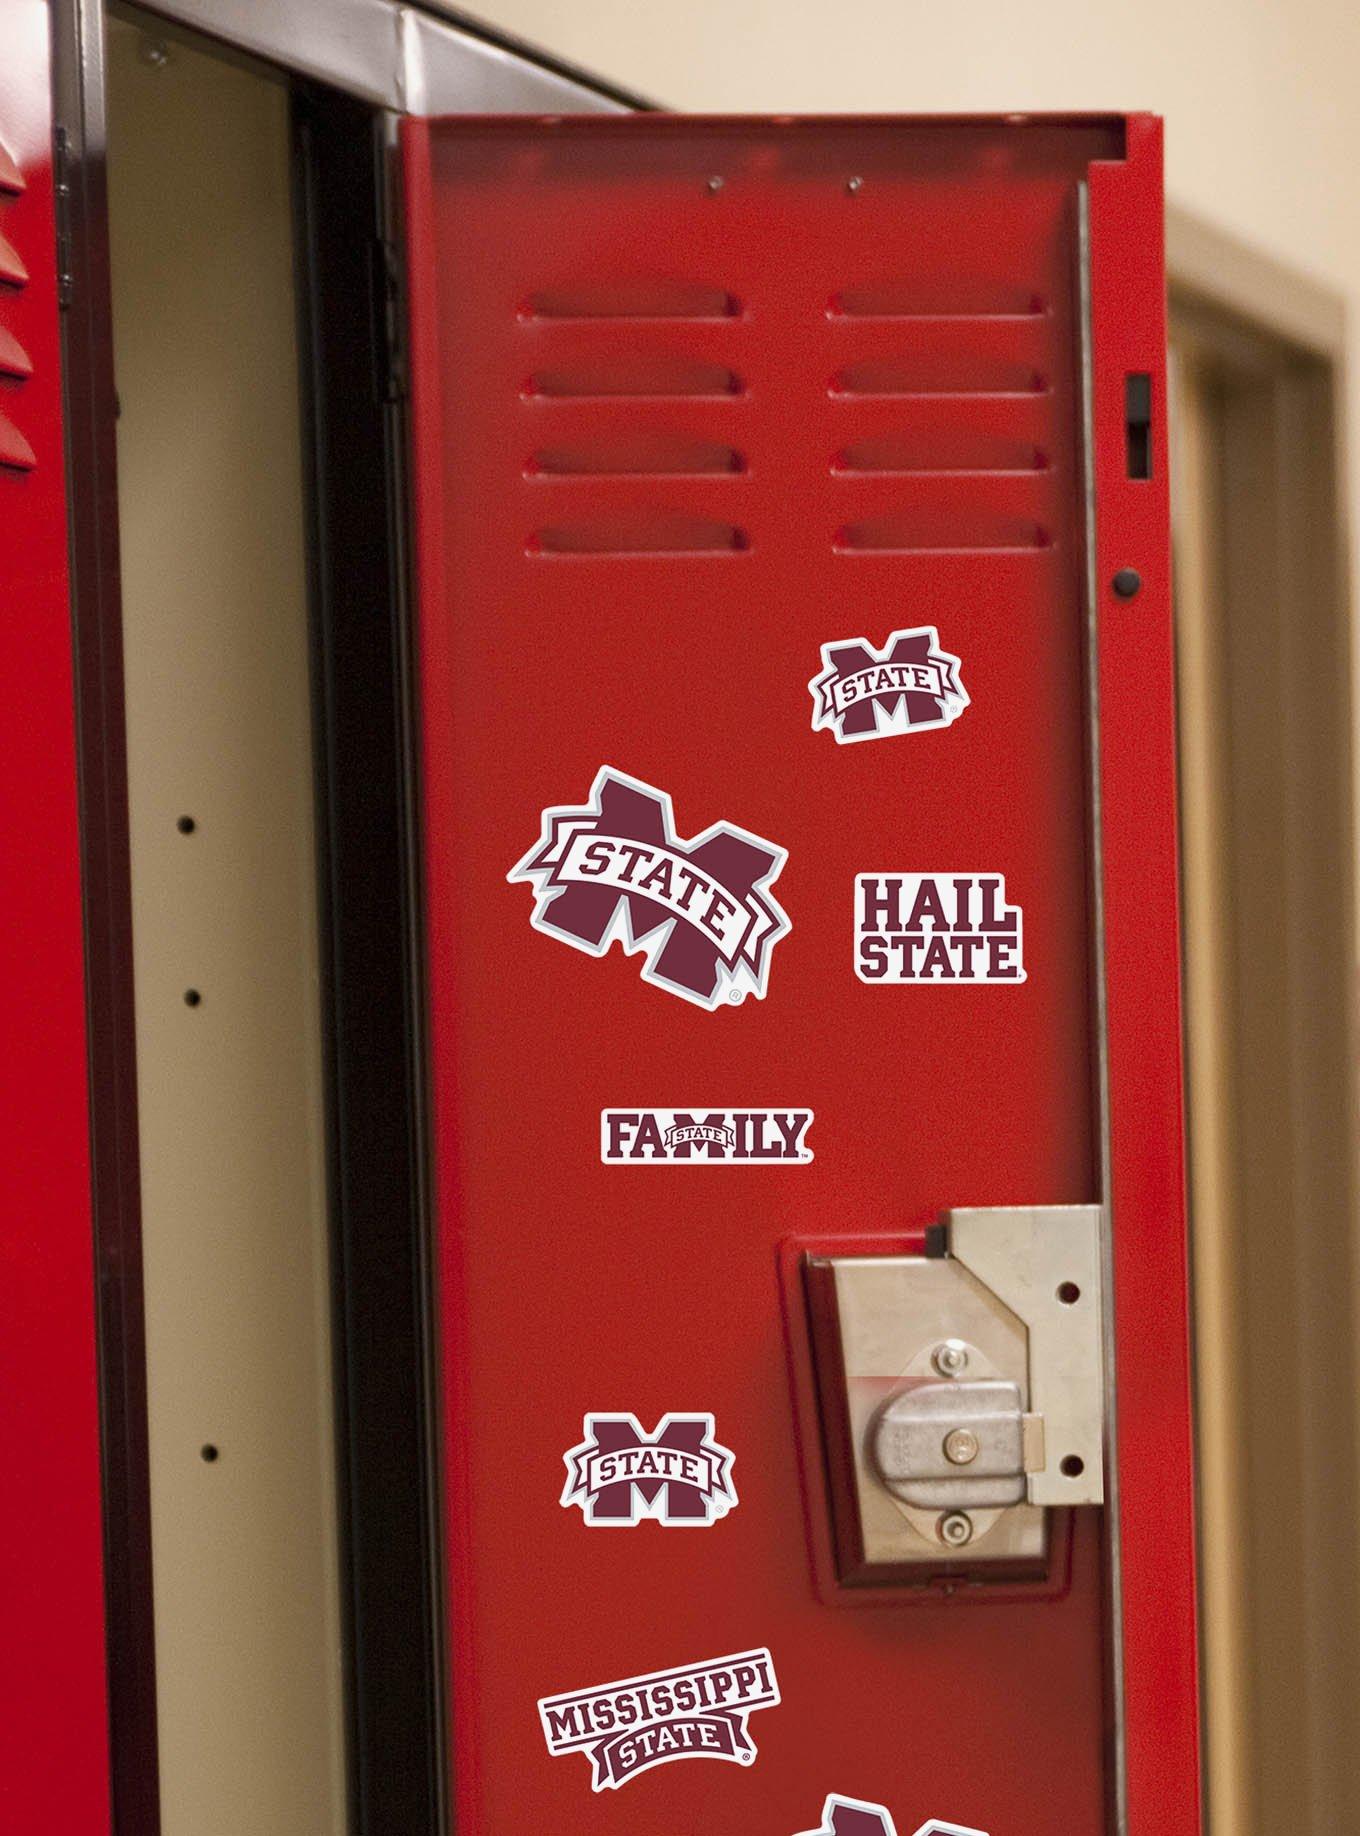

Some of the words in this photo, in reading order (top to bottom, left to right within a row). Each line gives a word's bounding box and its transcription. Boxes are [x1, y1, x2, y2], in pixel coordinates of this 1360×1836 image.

[842, 667, 931, 702] STATE
[579, 842, 736, 941] STATE
[861, 879, 1017, 932] HAIL
[860, 936, 1017, 978] STATE
[607, 1114, 808, 1158] FAMILY
[676, 1127, 722, 1142] STATE
[600, 1451, 698, 1482] STATE
[546, 1662, 773, 1742] MISSISSIPPI
[619, 1723, 720, 1768] STATE
